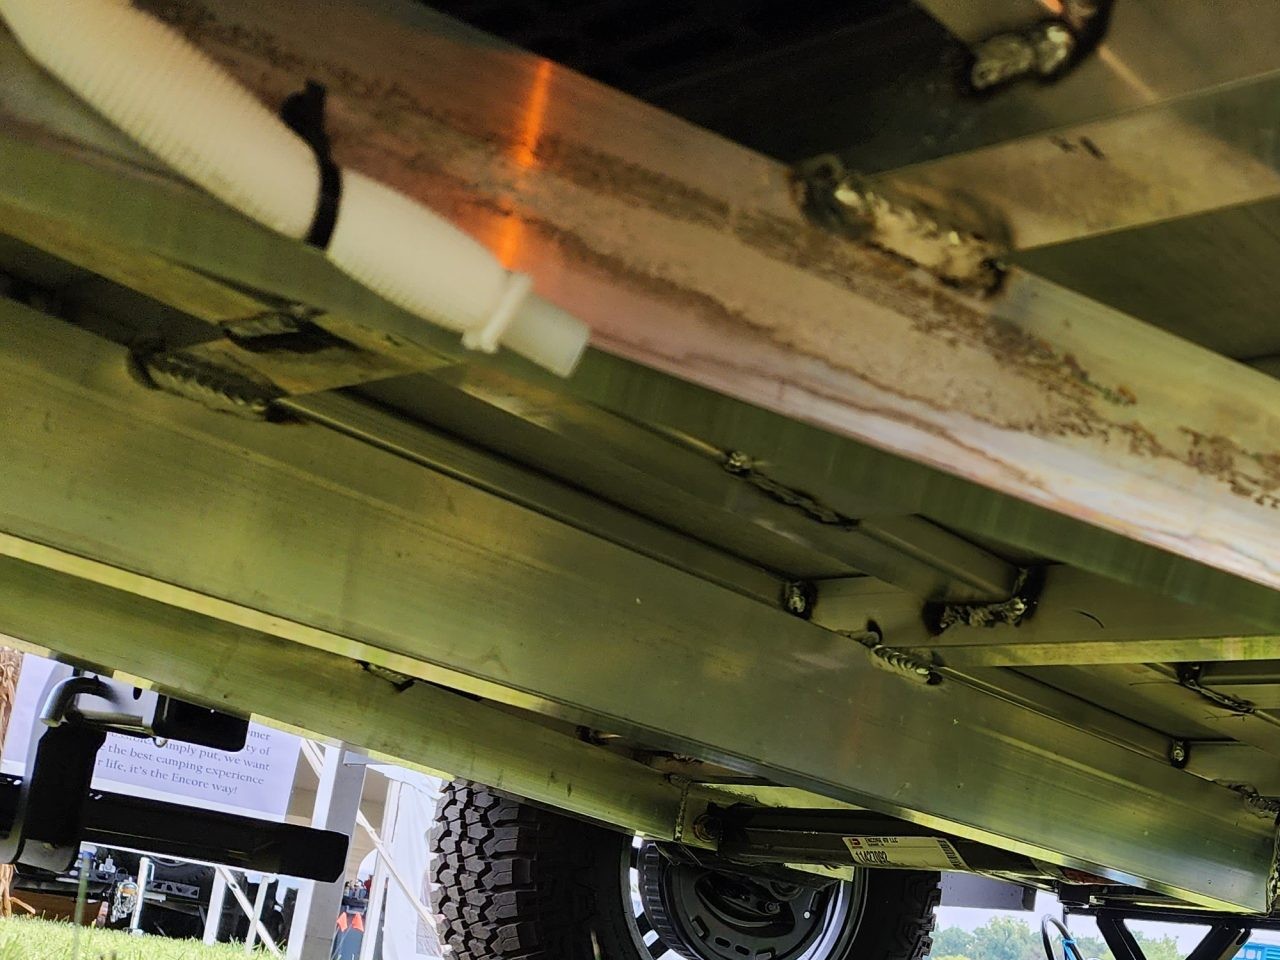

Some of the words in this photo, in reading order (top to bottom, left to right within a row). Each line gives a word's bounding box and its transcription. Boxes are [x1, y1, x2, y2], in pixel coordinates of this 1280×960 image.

[108, 744, 127, 755] the
[130, 750, 152, 762] best
[156, 756, 203, 774] camping
[205, 766, 264, 785] experience
[163, 741, 197, 757] imply
[224, 755, 241, 766] we
[243, 759, 270, 772] want
[259, 747, 270, 756] of
[106, 757, 127, 773] life,
[150, 768, 169, 780] the
[172, 772, 209, 789] Encore
[212, 782, 238, 796] way!
